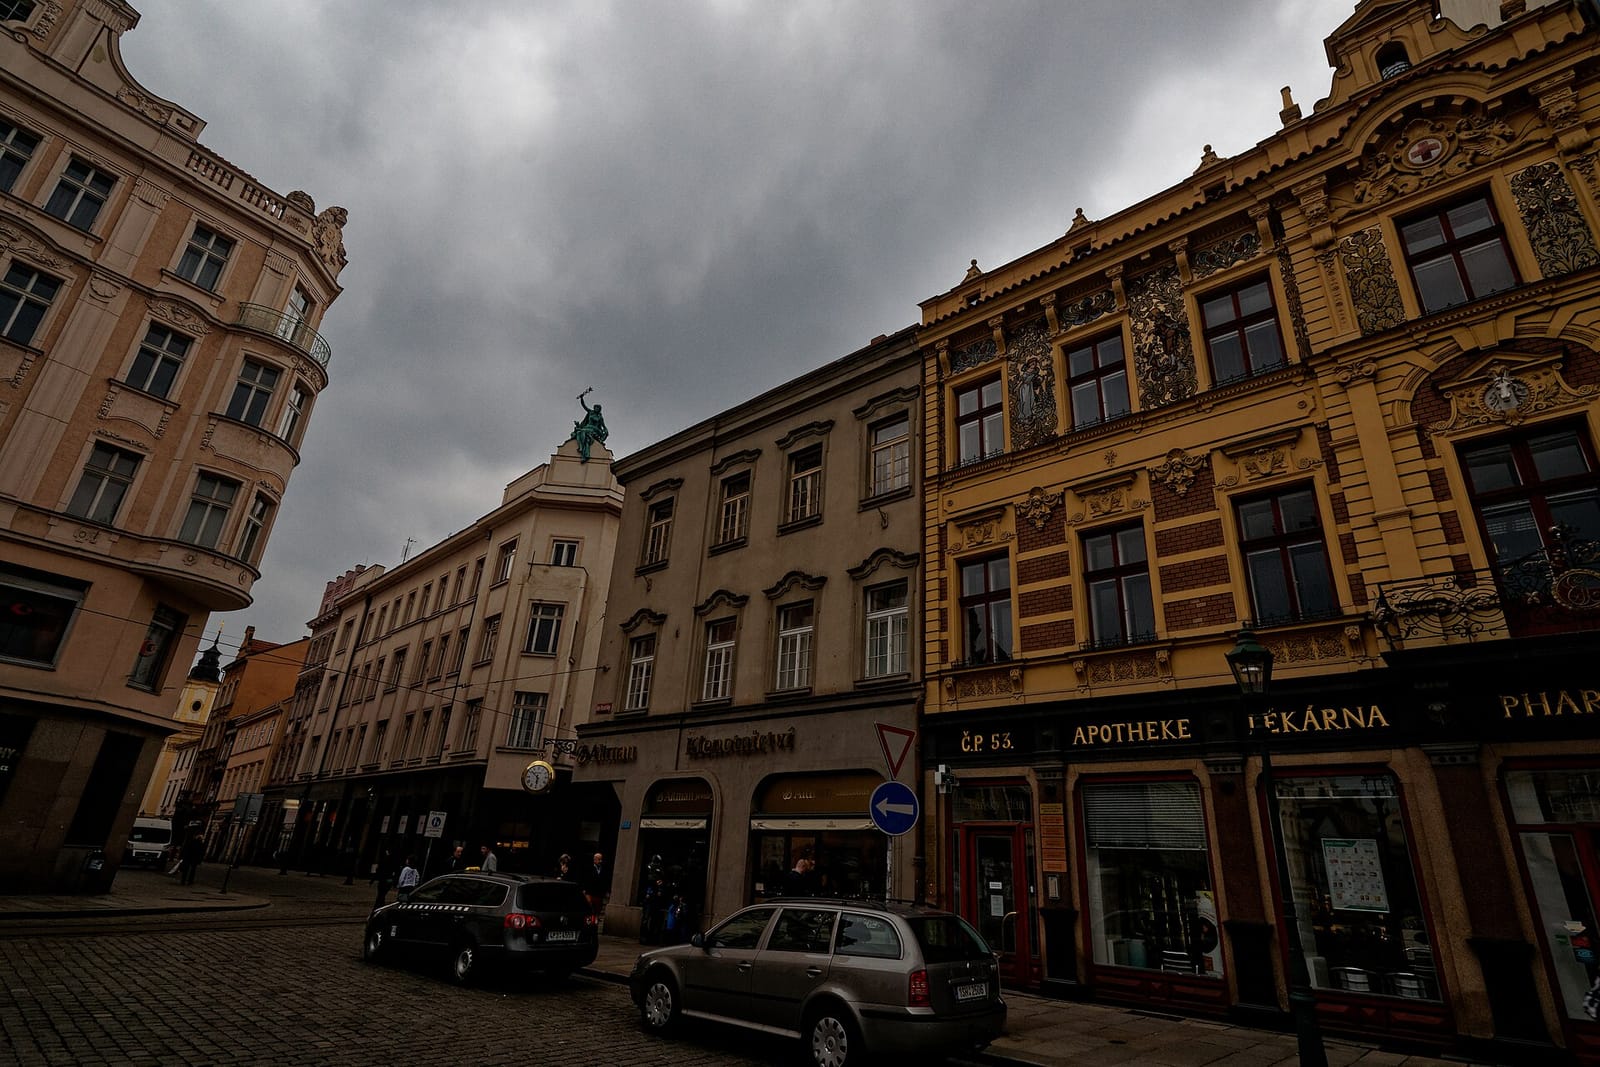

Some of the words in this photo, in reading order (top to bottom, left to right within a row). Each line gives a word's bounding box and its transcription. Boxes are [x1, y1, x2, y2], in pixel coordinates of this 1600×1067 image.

[961, 730, 983, 752] Č.P.
[991, 731, 1015, 750] 53.
[1072, 719, 1191, 745] APOTHEKE
